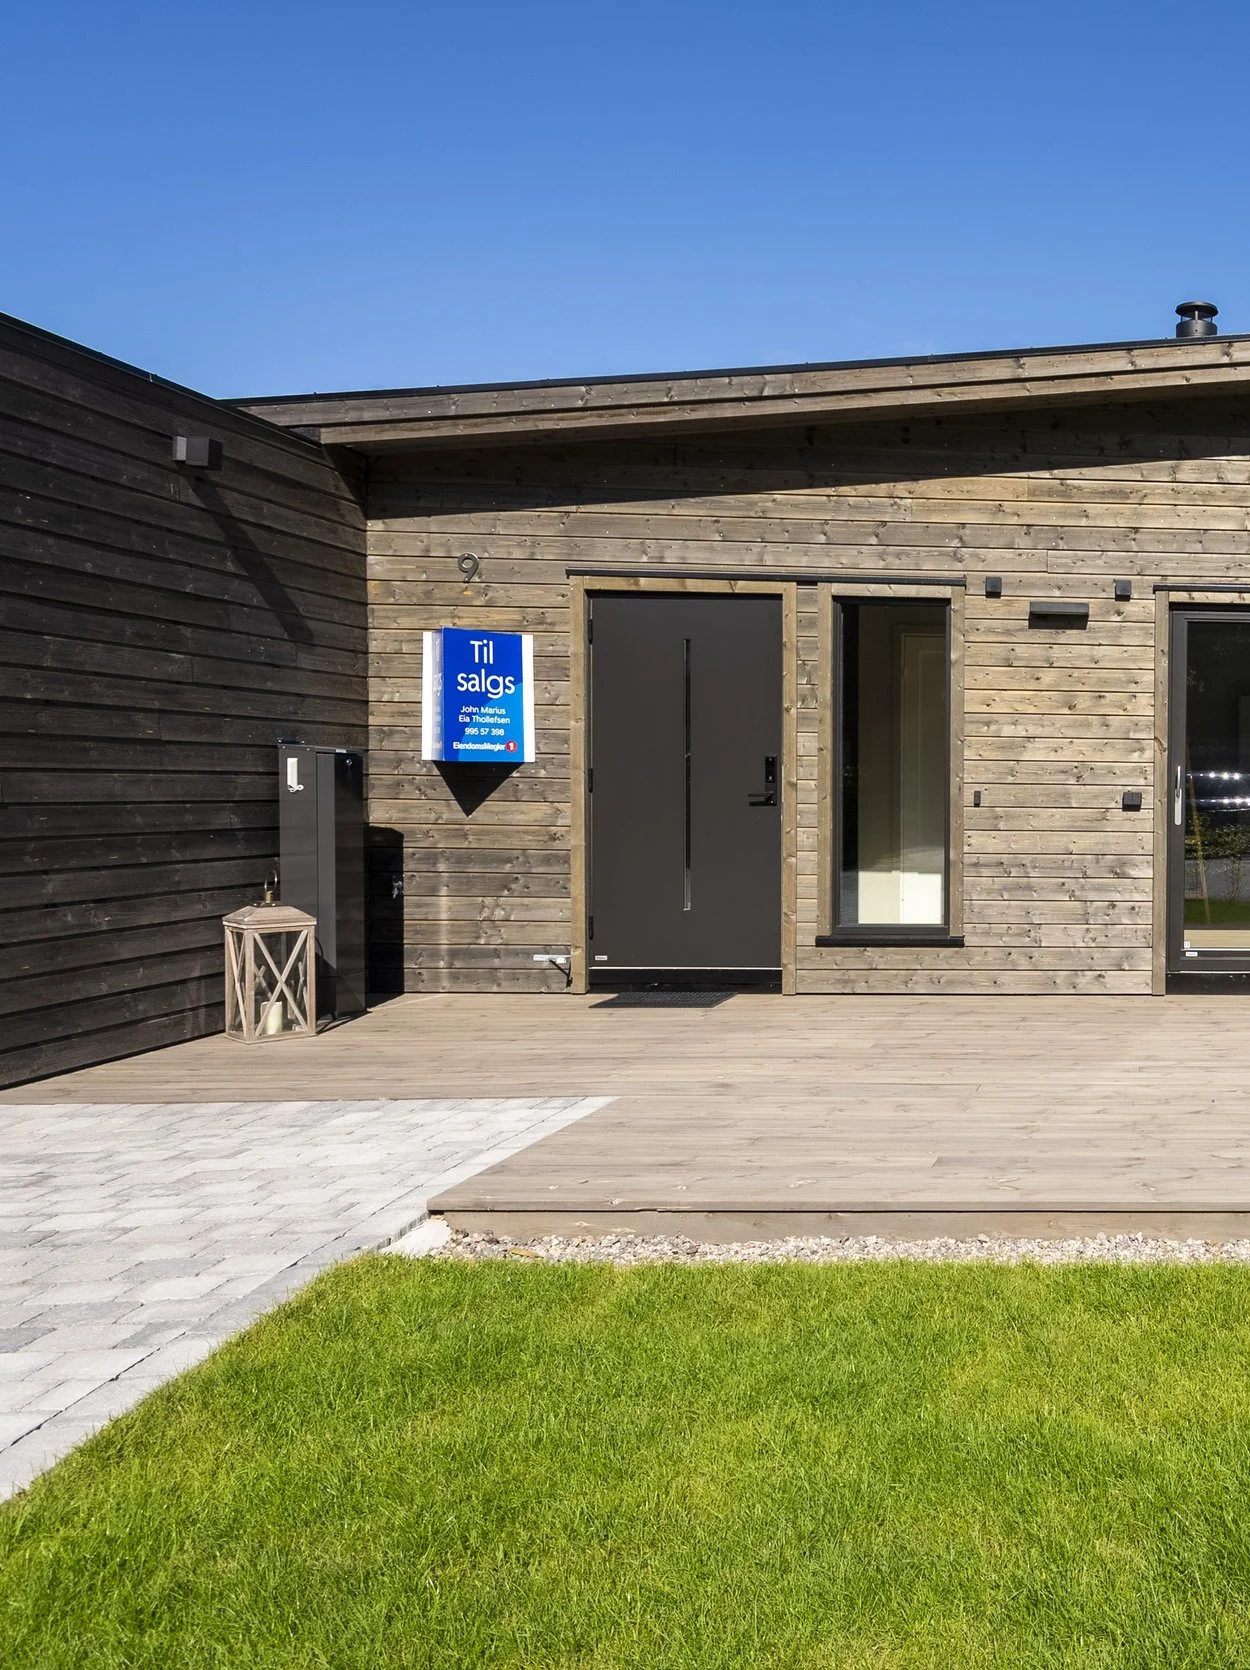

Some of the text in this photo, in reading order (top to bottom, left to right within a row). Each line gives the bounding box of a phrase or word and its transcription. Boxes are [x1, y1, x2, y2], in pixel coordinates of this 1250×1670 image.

[457, 553, 479, 583] 9
[470, 640, 493, 664] Til
[457, 668, 515, 699] salgs
[458, 714, 470, 723] Eia
[460, 705, 506, 715] John Marius
[464, 727, 479, 735] 995
[480, 728, 490, 736] 57
